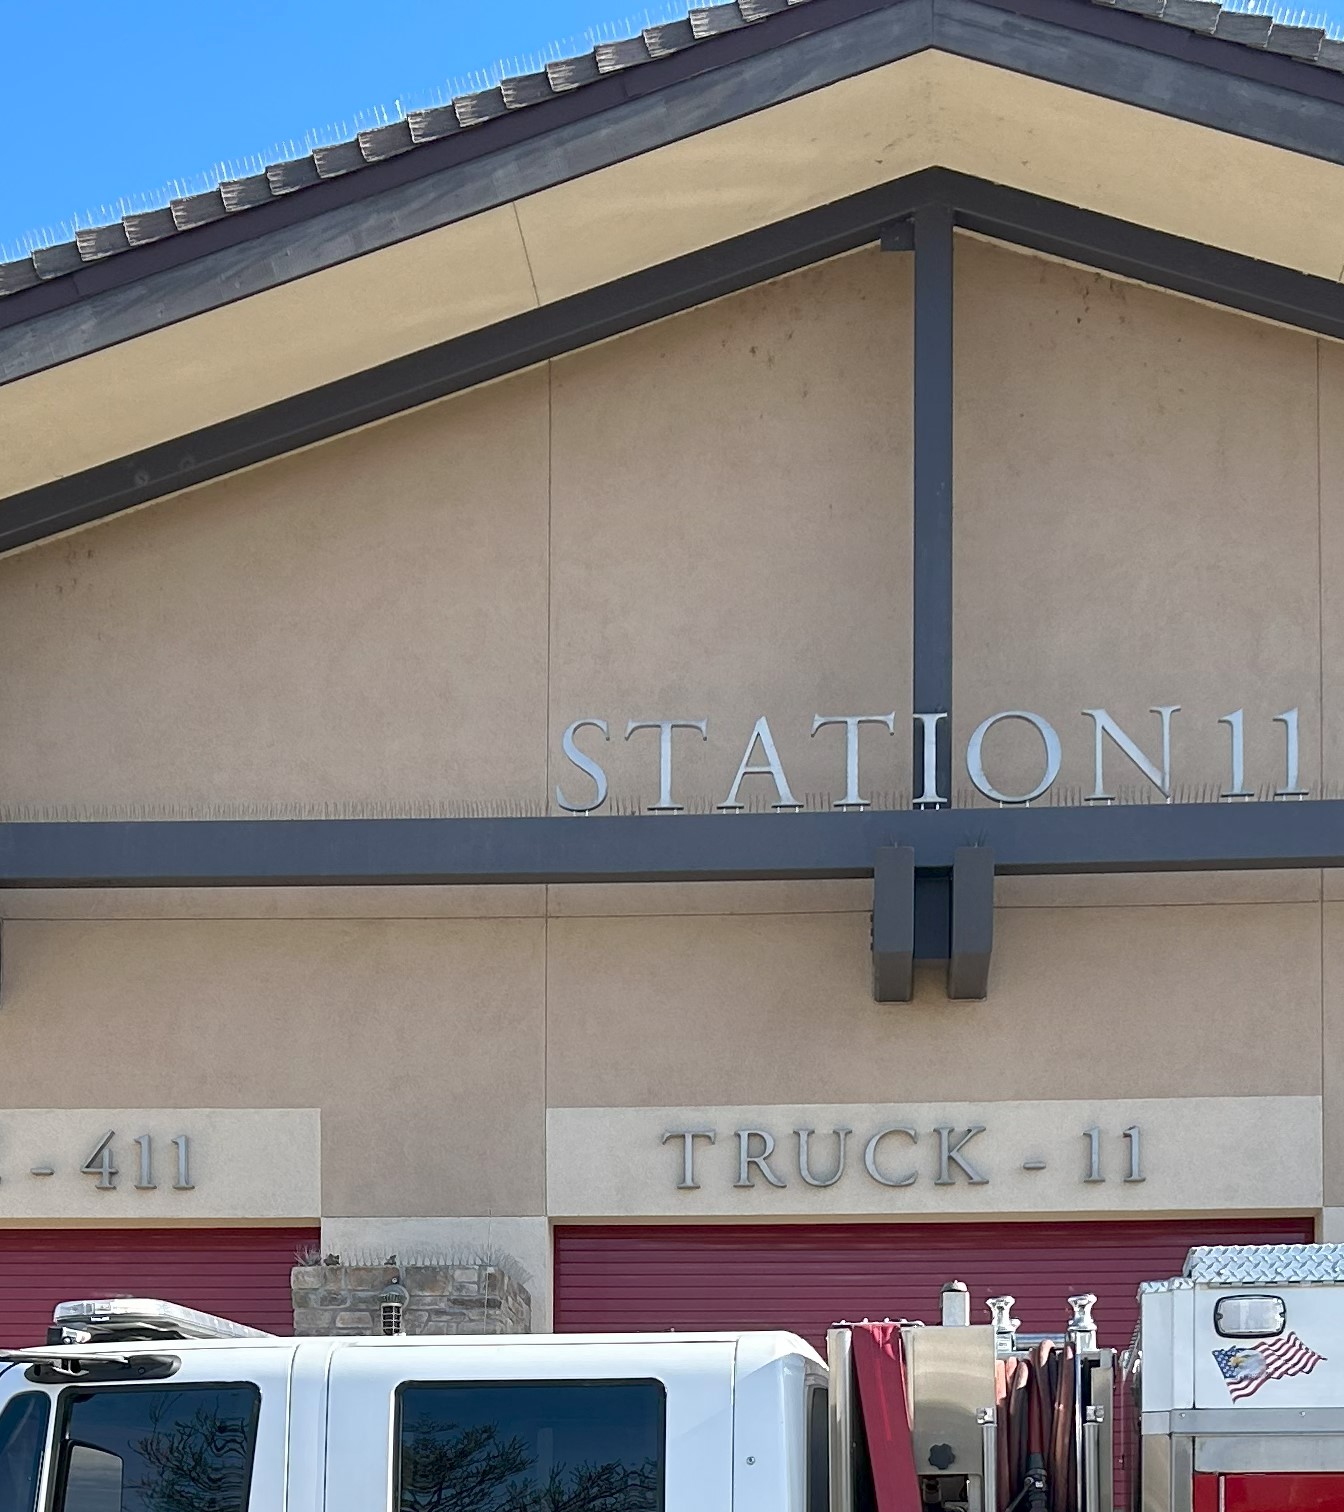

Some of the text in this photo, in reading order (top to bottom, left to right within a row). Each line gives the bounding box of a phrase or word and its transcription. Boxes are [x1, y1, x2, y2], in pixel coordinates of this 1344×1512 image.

[556, 705, 1310, 812] STATION 11
[80, 1129, 195, 1191] 411
[662, 1125, 990, 1190] TRUCK
[1081, 1124, 1147, 1184] 11
